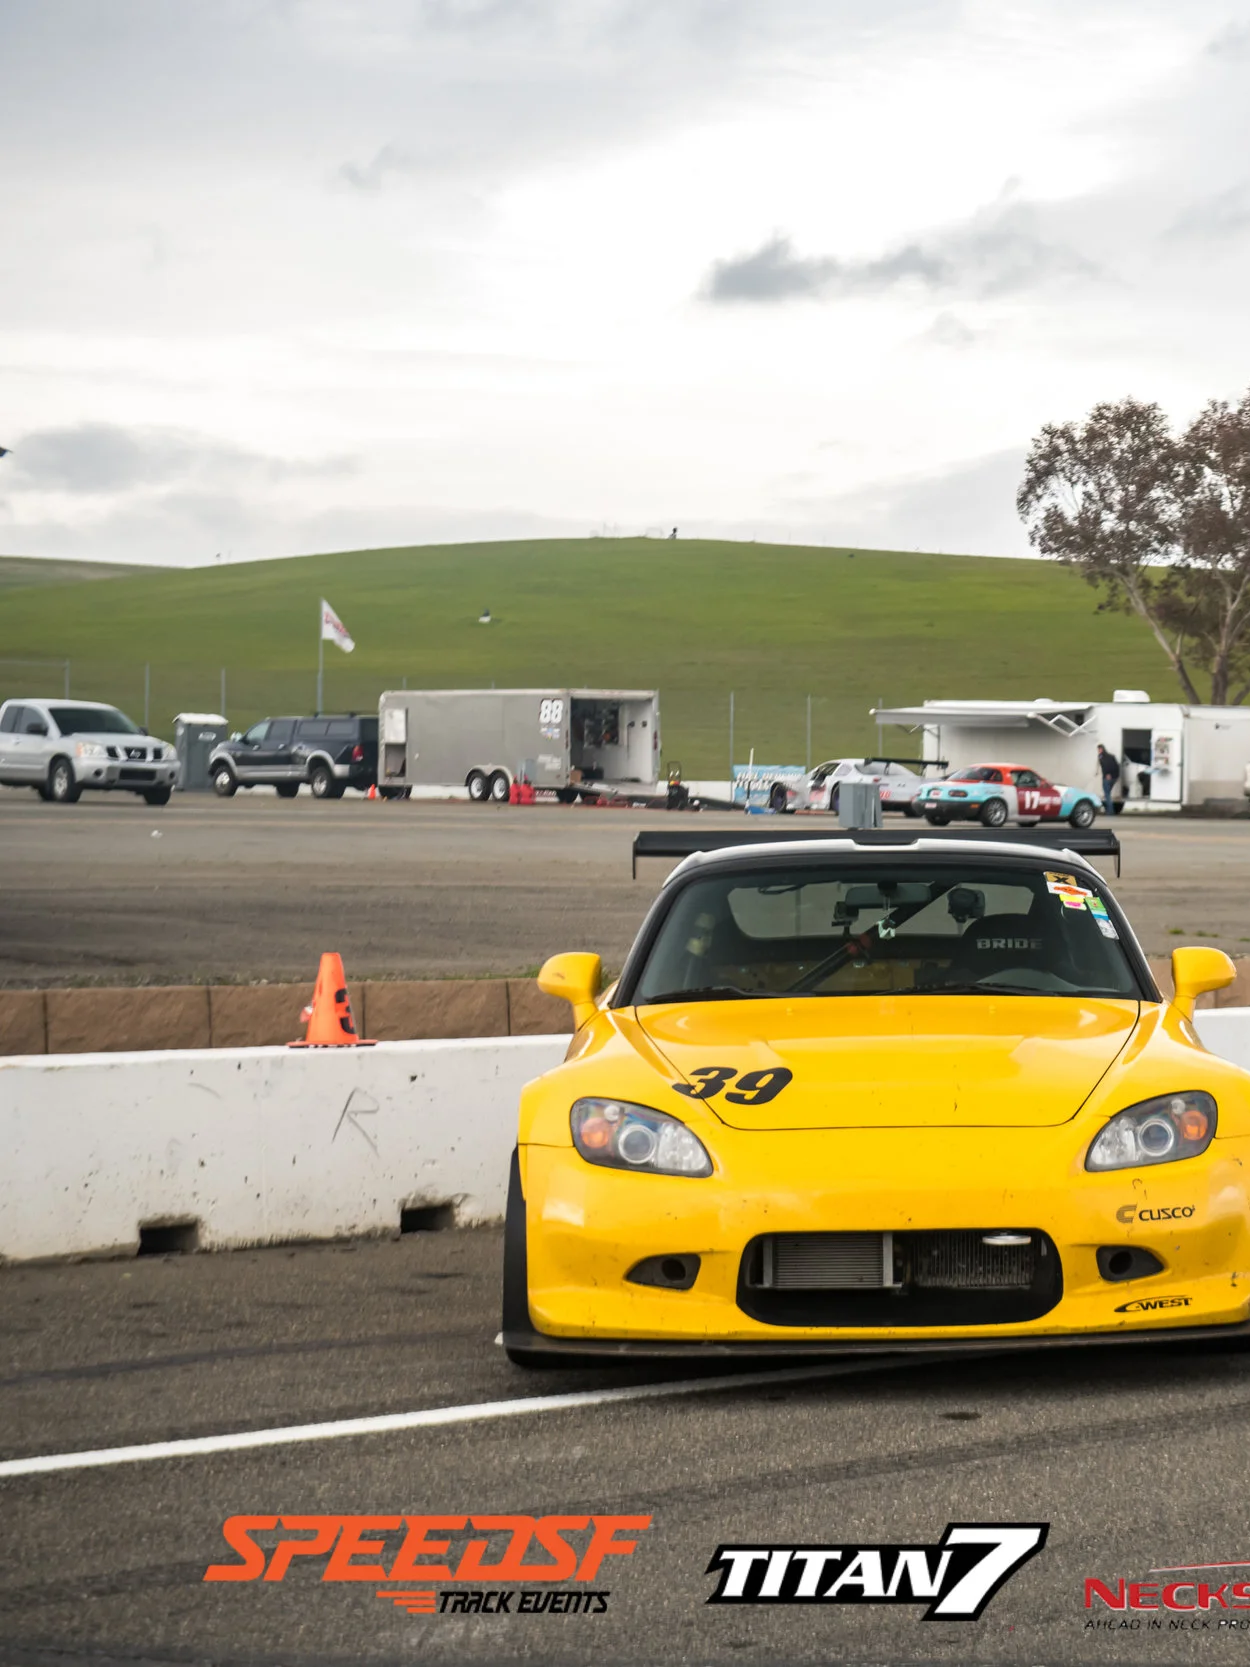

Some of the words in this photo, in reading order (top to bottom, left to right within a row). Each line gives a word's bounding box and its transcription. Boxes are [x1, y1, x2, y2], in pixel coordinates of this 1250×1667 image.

[539, 699, 563, 724] 88
[1024, 790, 1040, 810] 17
[976, 938, 1043, 950] BRIDE
[672, 1066, 793, 1106] 39
[1138, 1206, 1194, 1222] CUSCO
